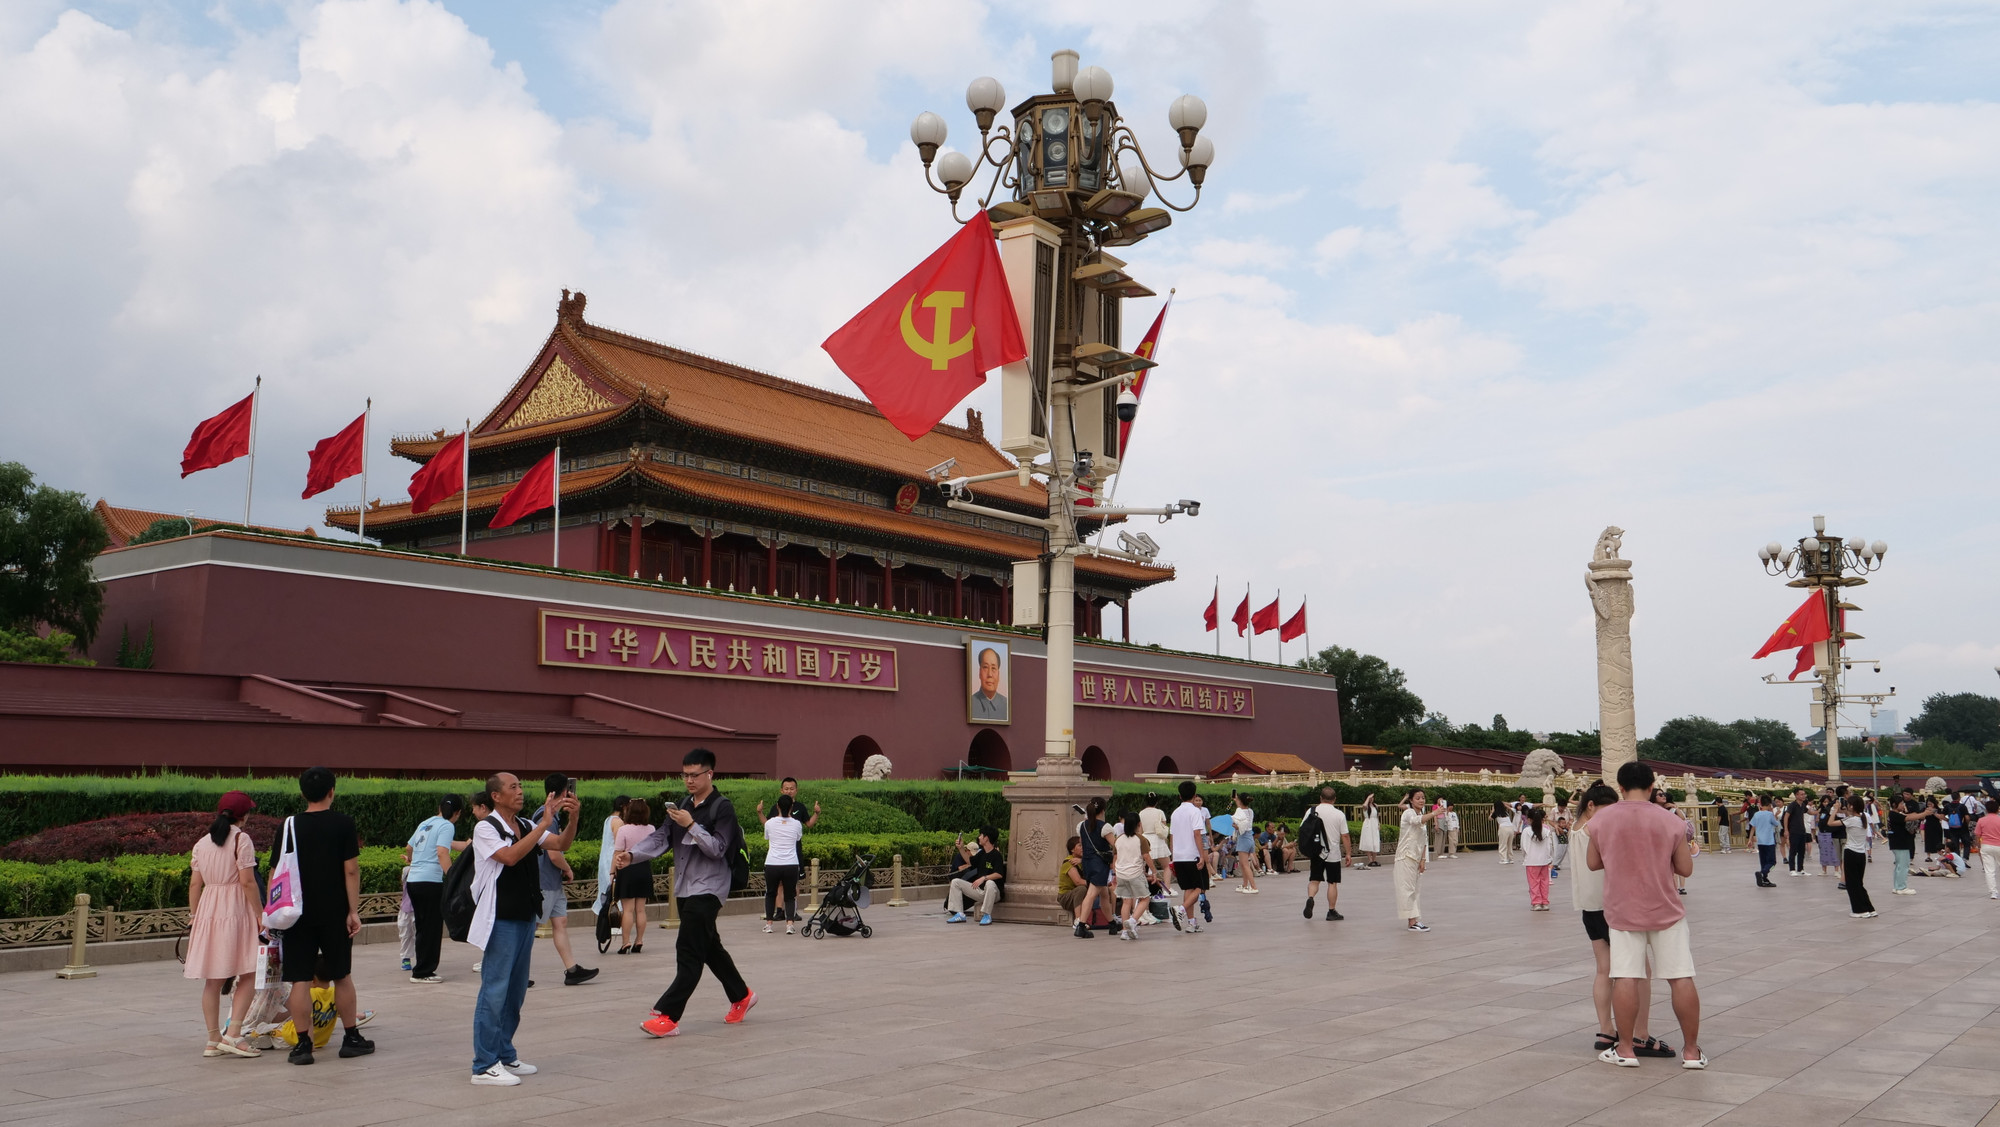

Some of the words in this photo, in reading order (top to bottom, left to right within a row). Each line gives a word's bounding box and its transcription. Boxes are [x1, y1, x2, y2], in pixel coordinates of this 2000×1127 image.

[565, 623, 882, 682] 中华人民共和国万岁
[1080, 675, 1246, 712] 世界人民大团结万岁
